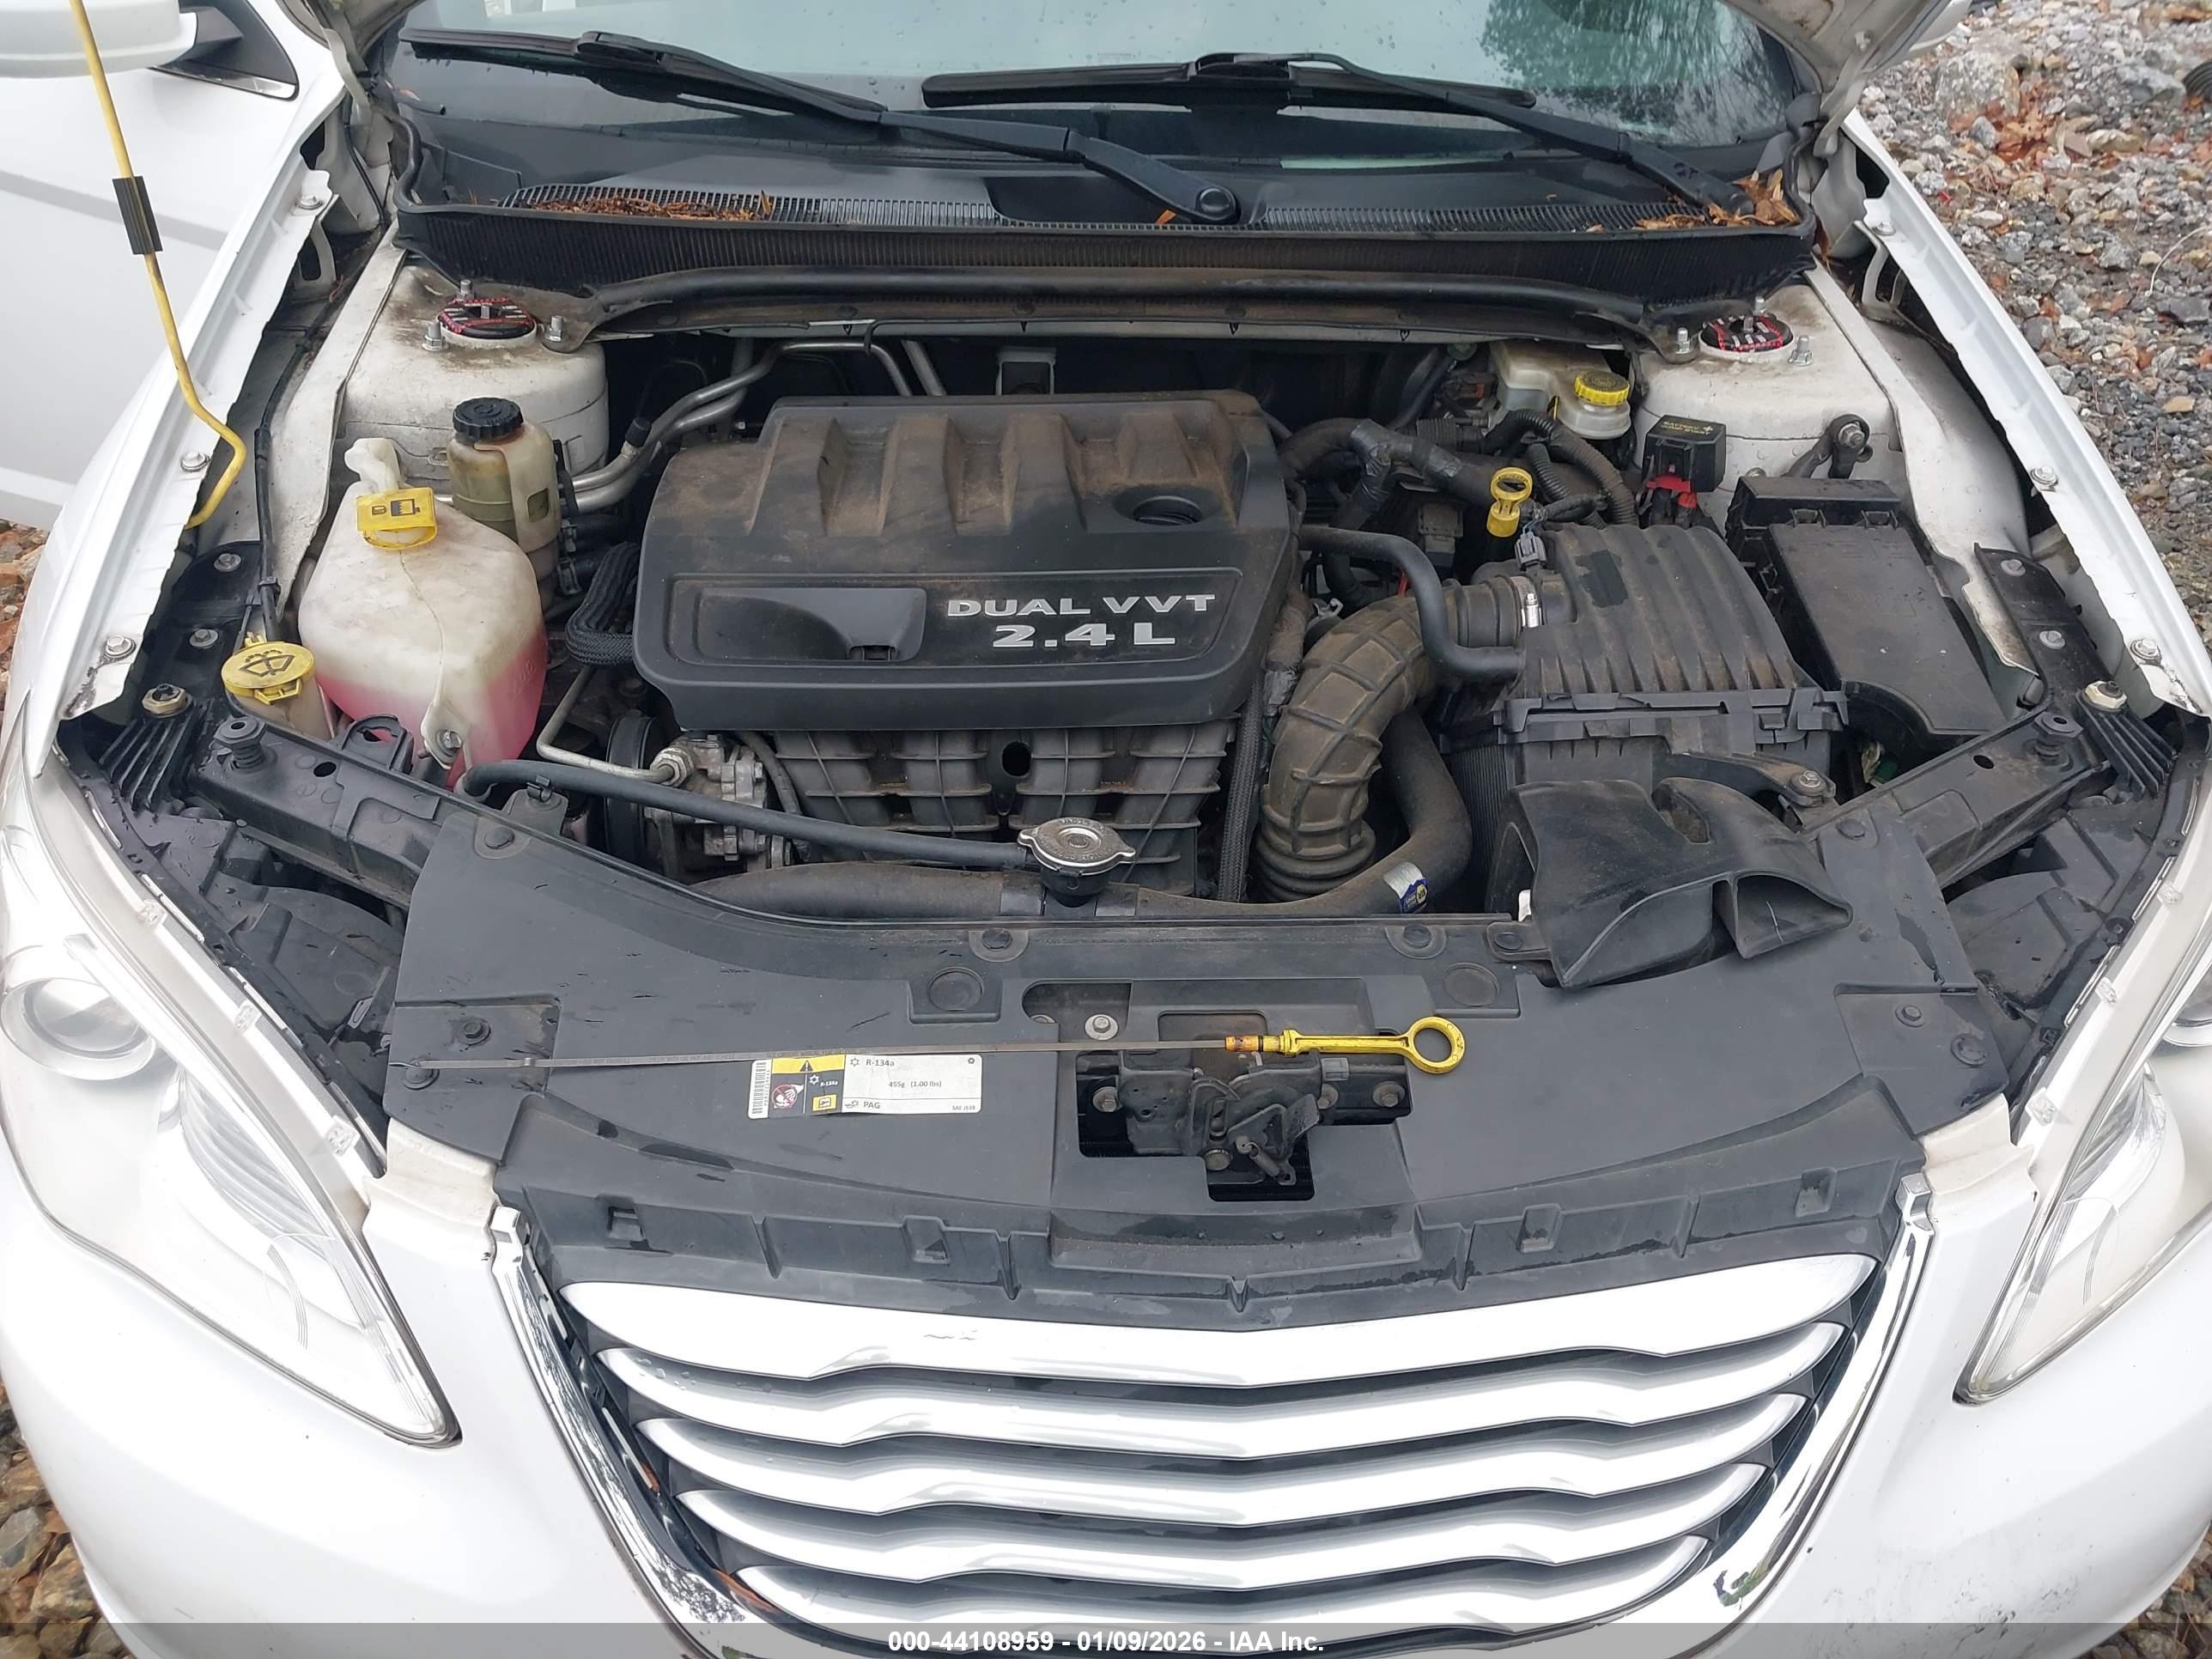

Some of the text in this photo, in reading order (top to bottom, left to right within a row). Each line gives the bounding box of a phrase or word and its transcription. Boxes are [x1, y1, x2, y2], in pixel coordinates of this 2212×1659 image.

[947, 594, 1216, 617] DUAL VVT
[993, 623, 1176, 647] 2.4 L
[863, 1101, 881, 1109] PAG
